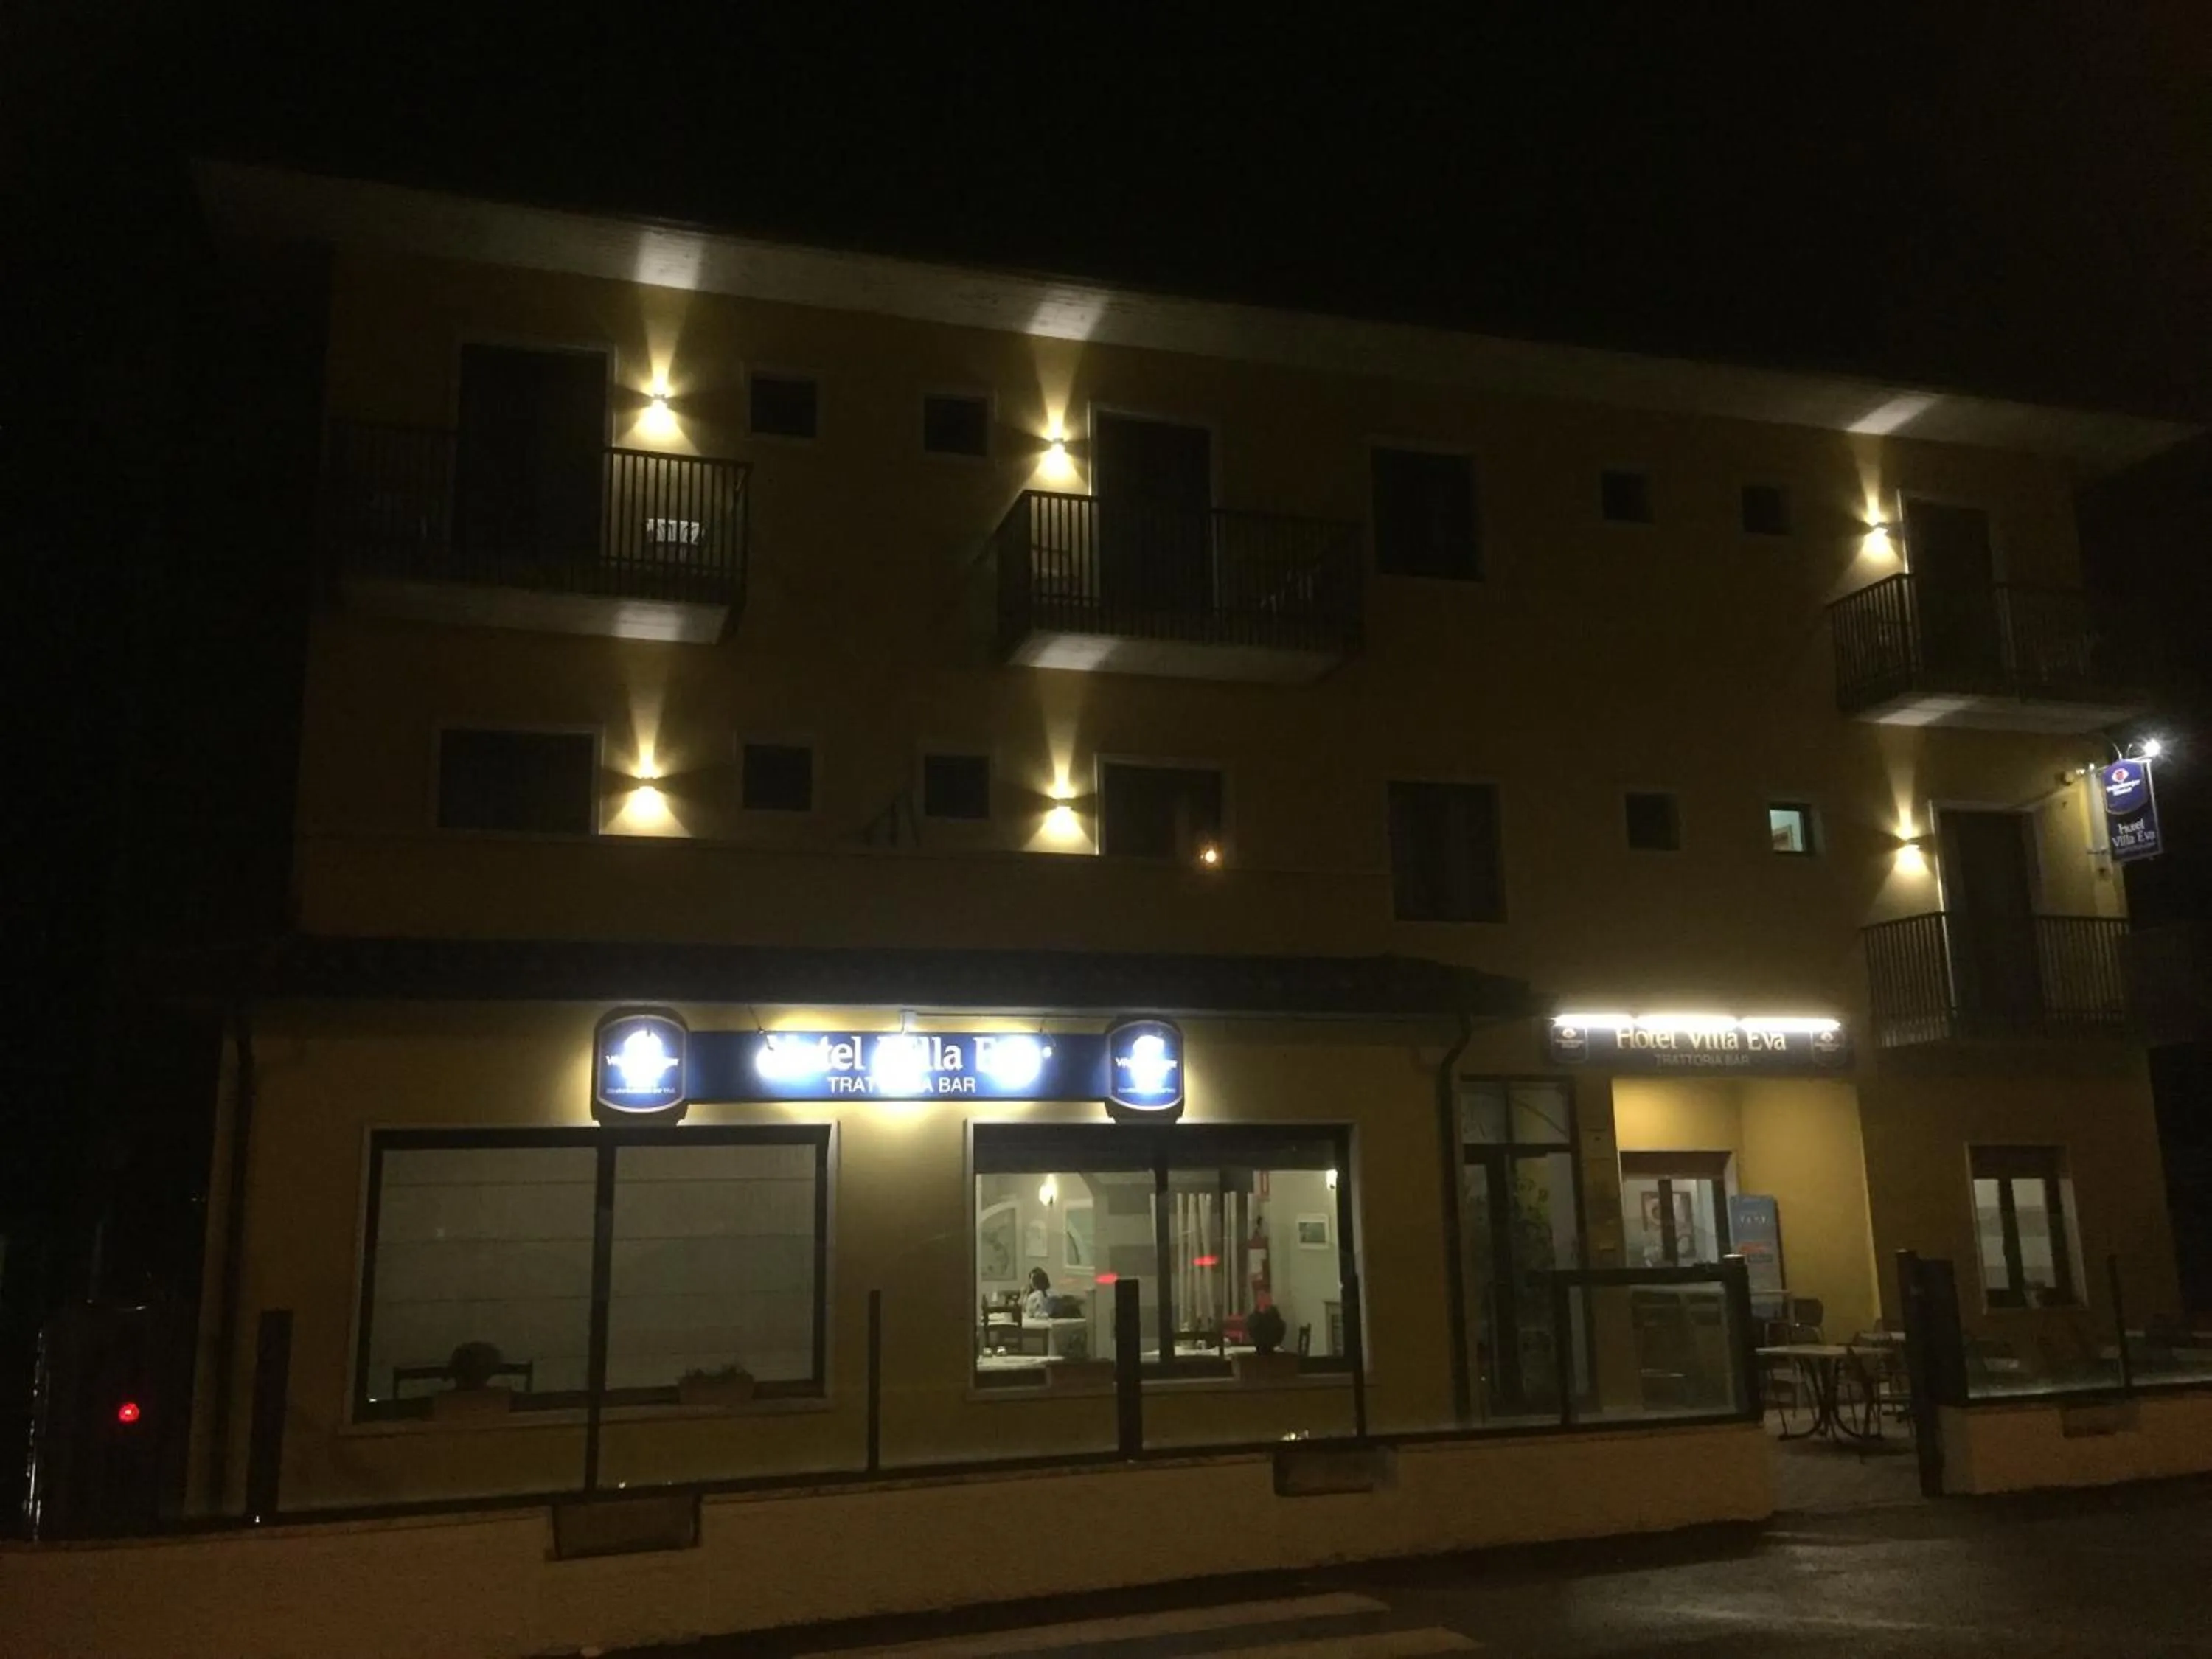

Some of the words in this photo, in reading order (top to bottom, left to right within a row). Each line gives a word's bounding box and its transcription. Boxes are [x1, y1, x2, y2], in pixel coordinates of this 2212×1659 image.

[1615, 1024, 1677, 1050] Hotel
[1745, 1029, 1787, 1051] Eva
[938, 1077, 976, 1093] BAR
